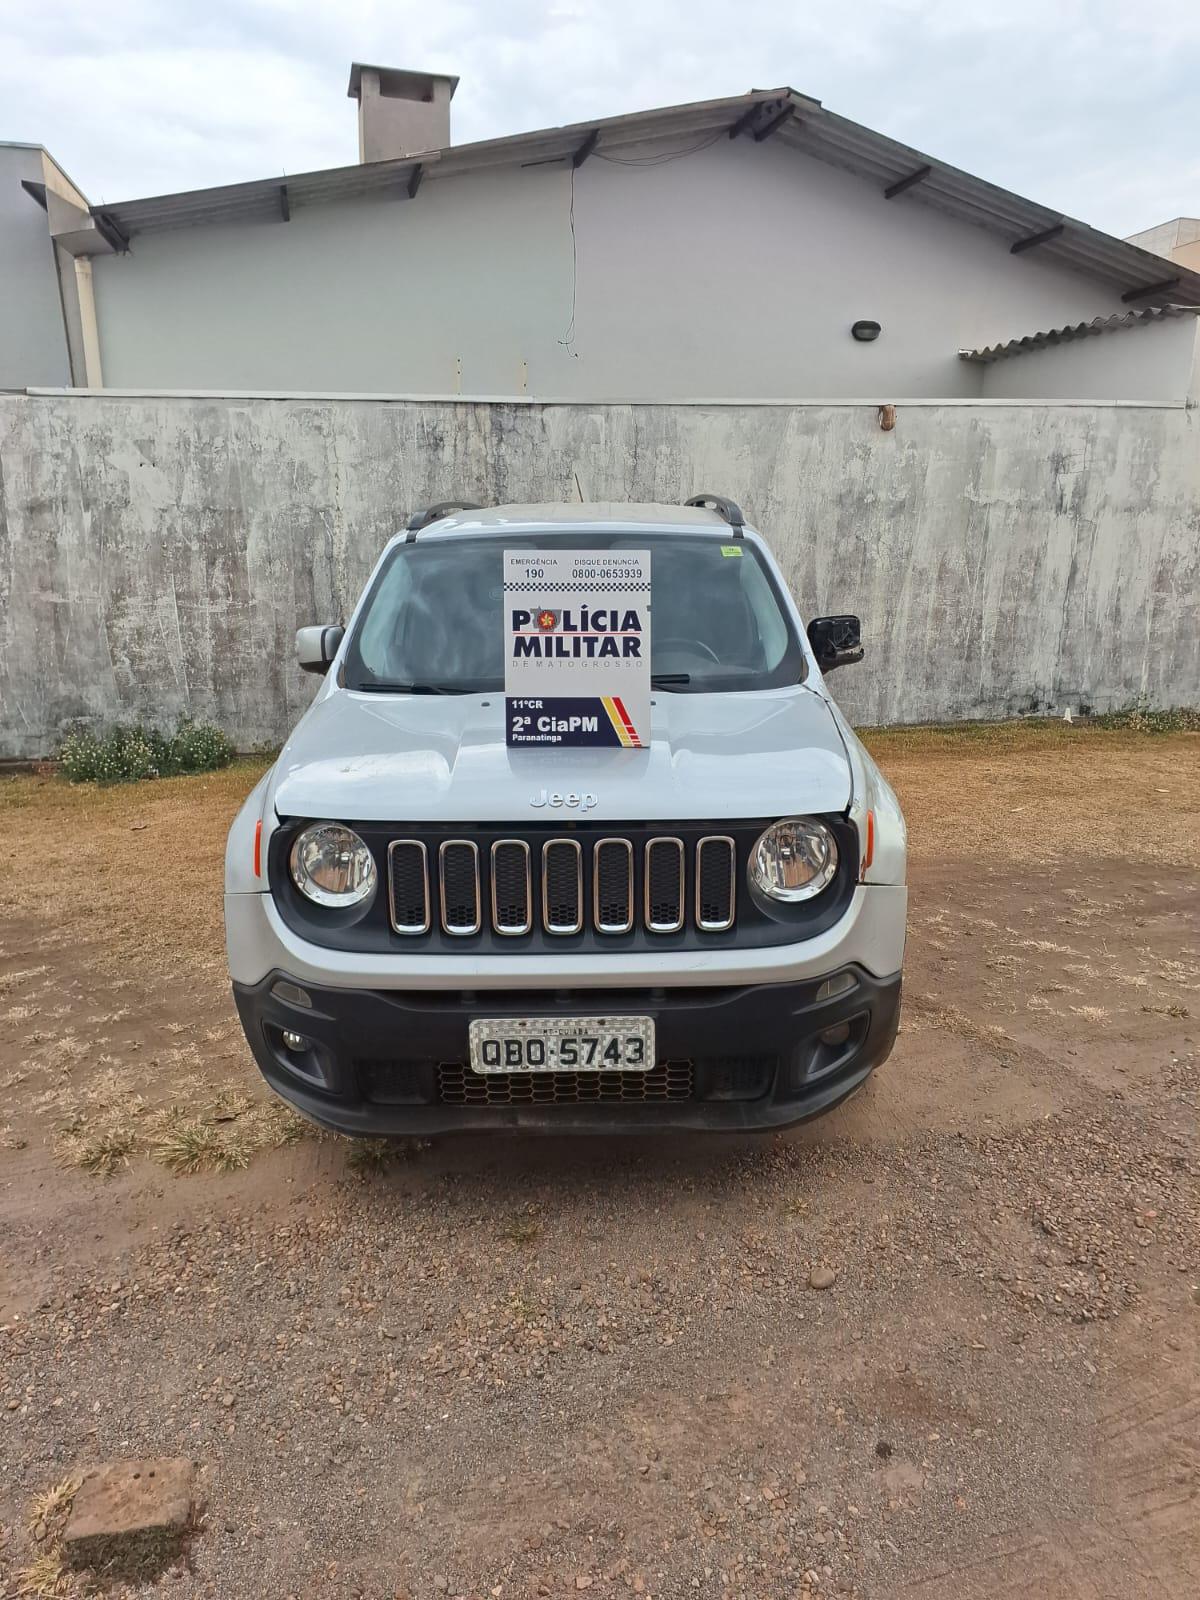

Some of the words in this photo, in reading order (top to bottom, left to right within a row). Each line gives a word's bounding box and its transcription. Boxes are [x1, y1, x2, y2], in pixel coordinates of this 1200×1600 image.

[525, 569, 544, 578] 190
[572, 569, 643, 579] 0800-0653939
[513, 636, 642, 658] MILITAR
[581, 660, 643, 668] GROSSO
[512, 716, 532, 732] 2ª
[537, 716, 598, 732] CiaPM
[512, 733, 562, 742] Paranatinga
[529, 789, 599, 812] Jeep
